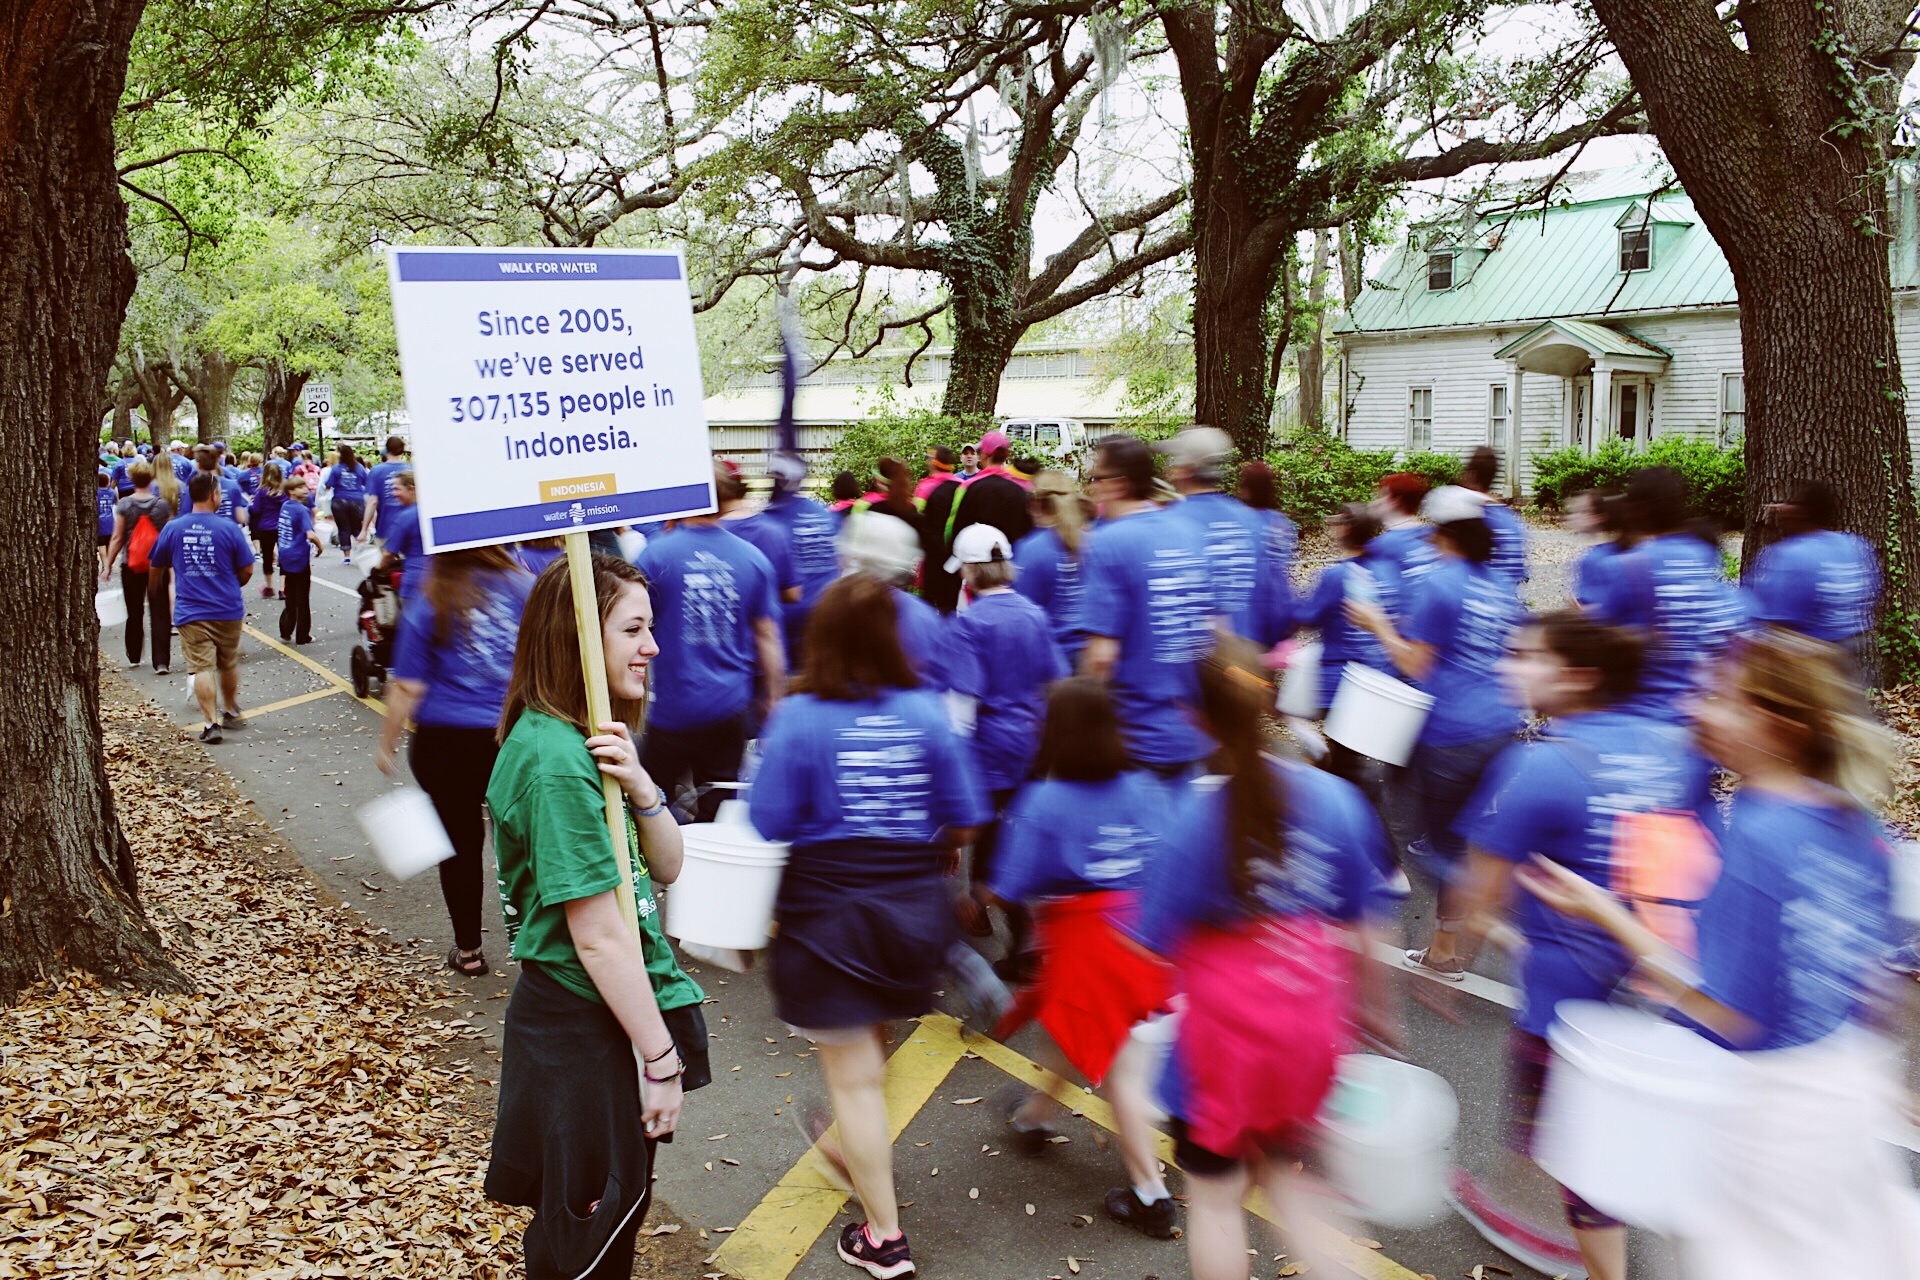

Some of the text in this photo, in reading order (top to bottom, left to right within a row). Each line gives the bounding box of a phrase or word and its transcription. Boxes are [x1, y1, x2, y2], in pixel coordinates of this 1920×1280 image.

[498, 262, 598, 274] WALK FOR WATER
[478, 308, 633, 337] Since 2005,
[562, 346, 644, 374] served
[308, 401, 329, 413] 20
[449, 383, 675, 424] 307,135 people in
[505, 426, 638, 460] Indonesia.
[550, 481, 606, 497] INDONESIA
[543, 504, 618, 522] water mission
